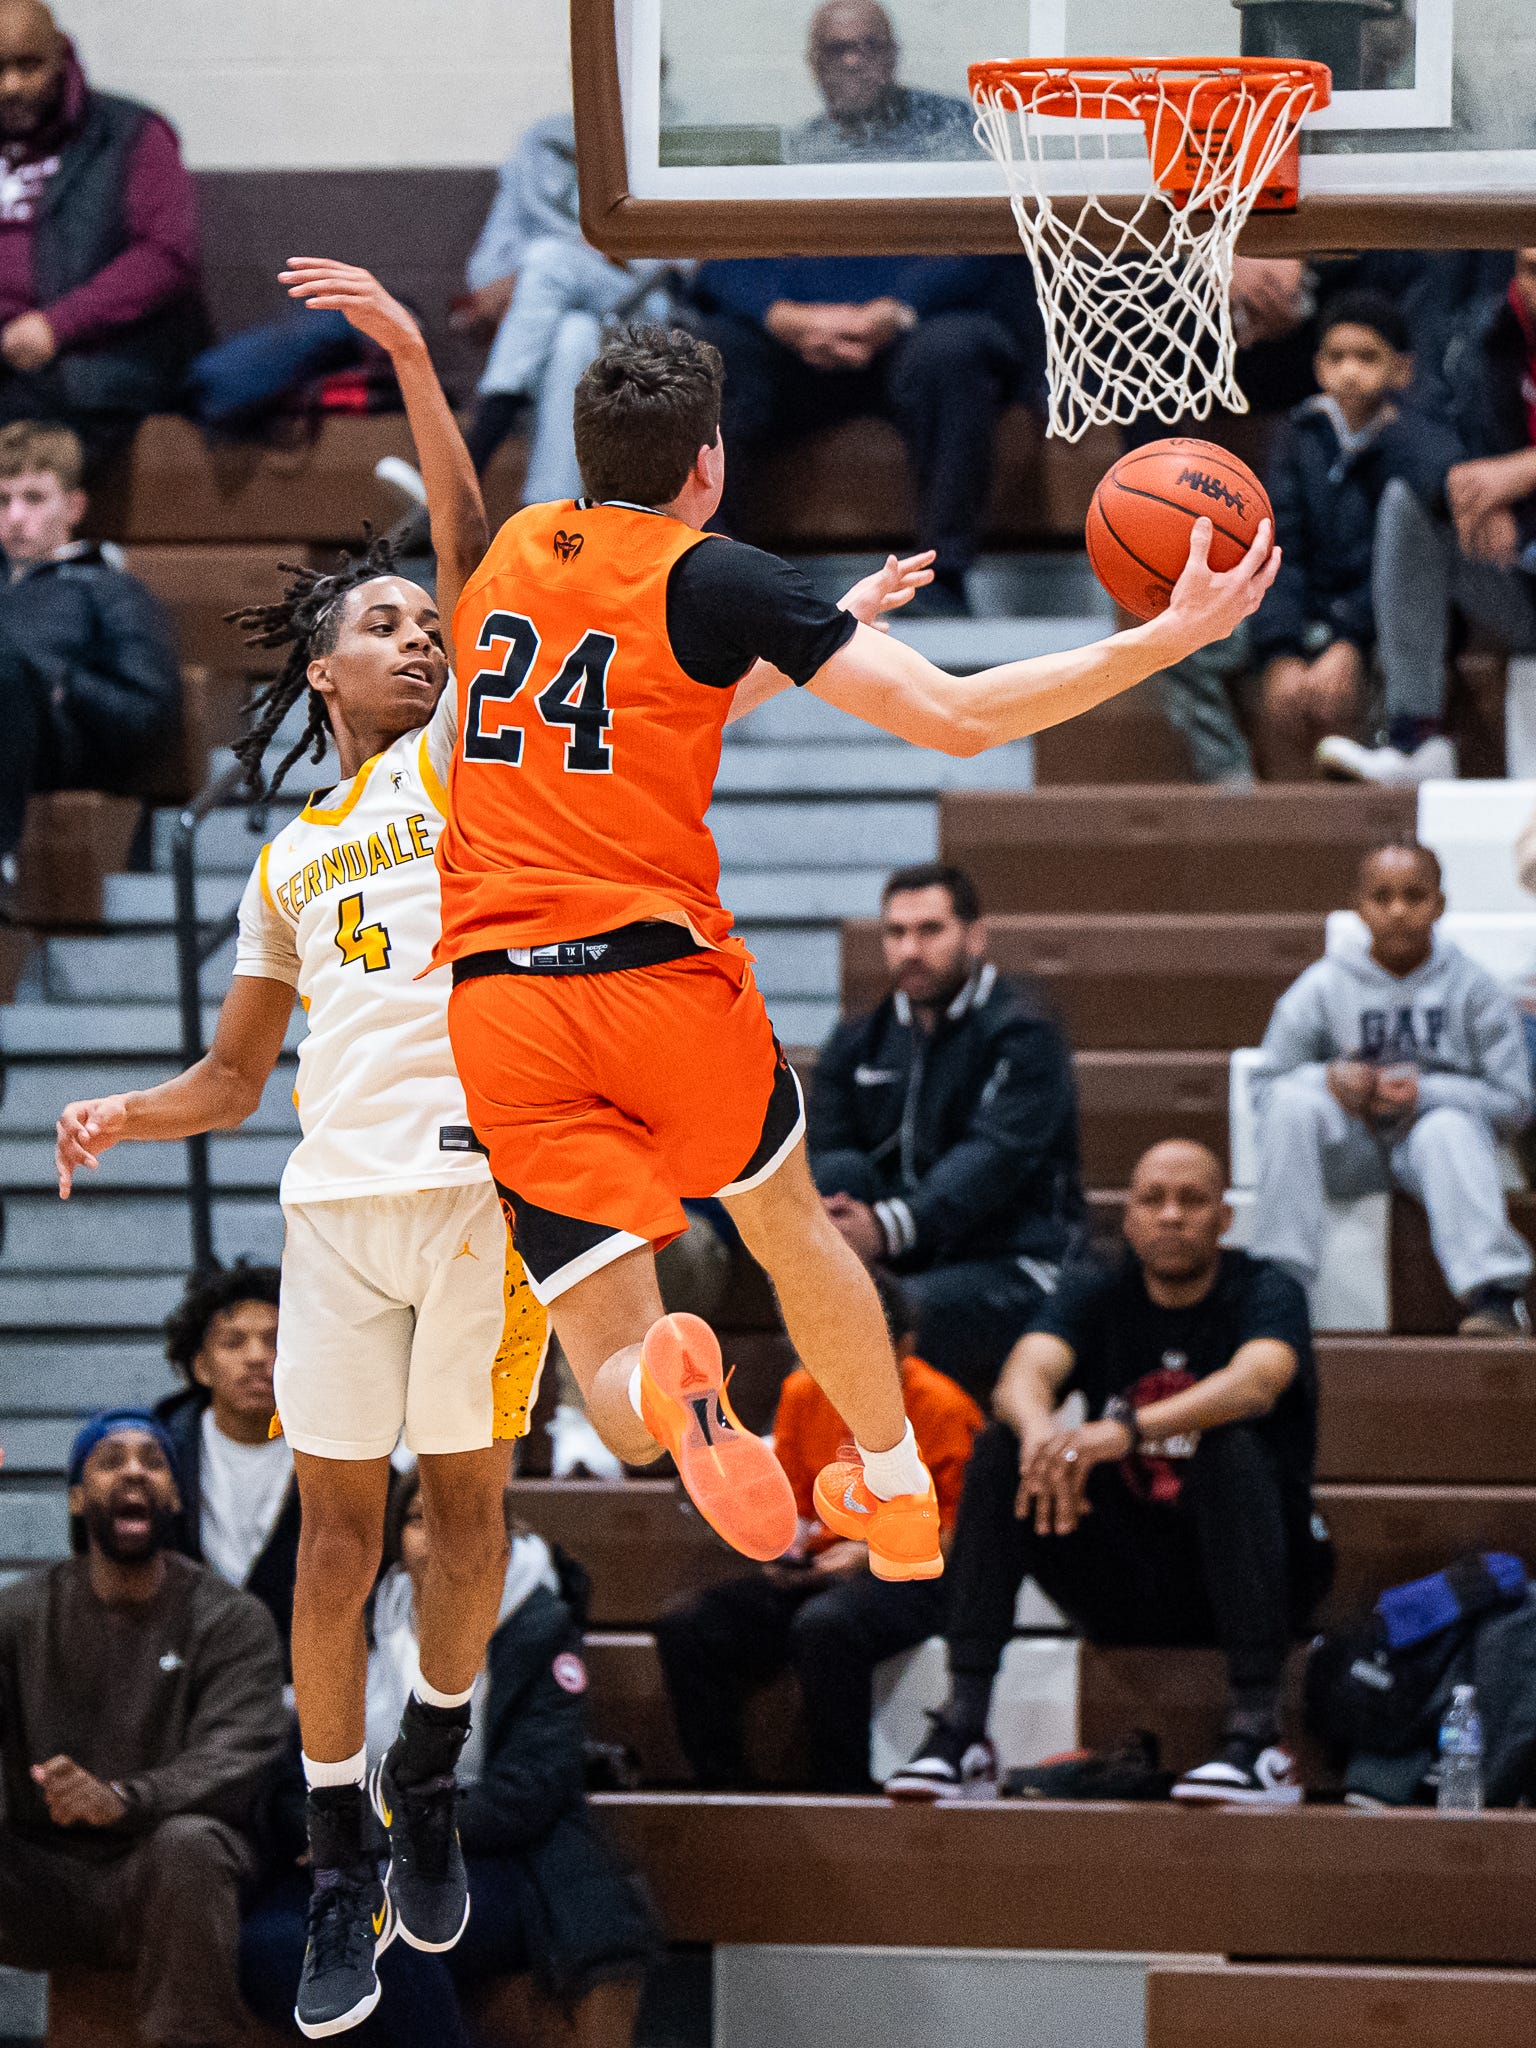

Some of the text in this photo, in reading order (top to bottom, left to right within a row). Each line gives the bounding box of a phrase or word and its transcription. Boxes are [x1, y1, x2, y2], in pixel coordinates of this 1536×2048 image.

[463, 609, 618, 775] 24
[276, 813, 434, 923] FERNDALE
[334, 891, 392, 973] 4
